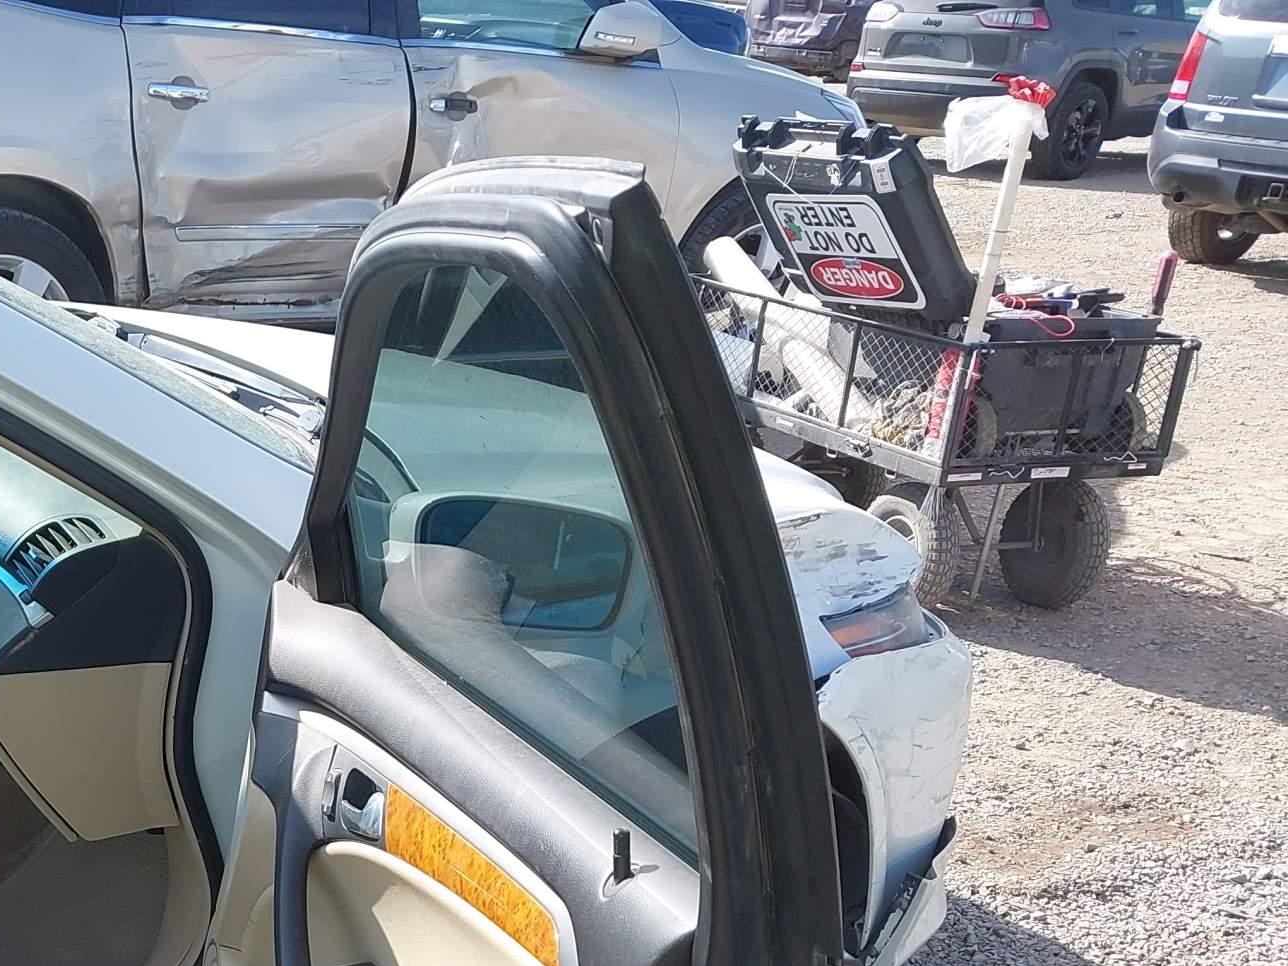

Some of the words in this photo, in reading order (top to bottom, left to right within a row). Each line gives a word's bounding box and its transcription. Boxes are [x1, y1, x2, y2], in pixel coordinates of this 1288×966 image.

[922, 17, 943, 28] Jeep
[795, 205, 857, 228] ENTER
[804, 230, 844, 253] NOT
[844, 231, 877, 255] DO
[818, 266, 896, 290] DANGER
